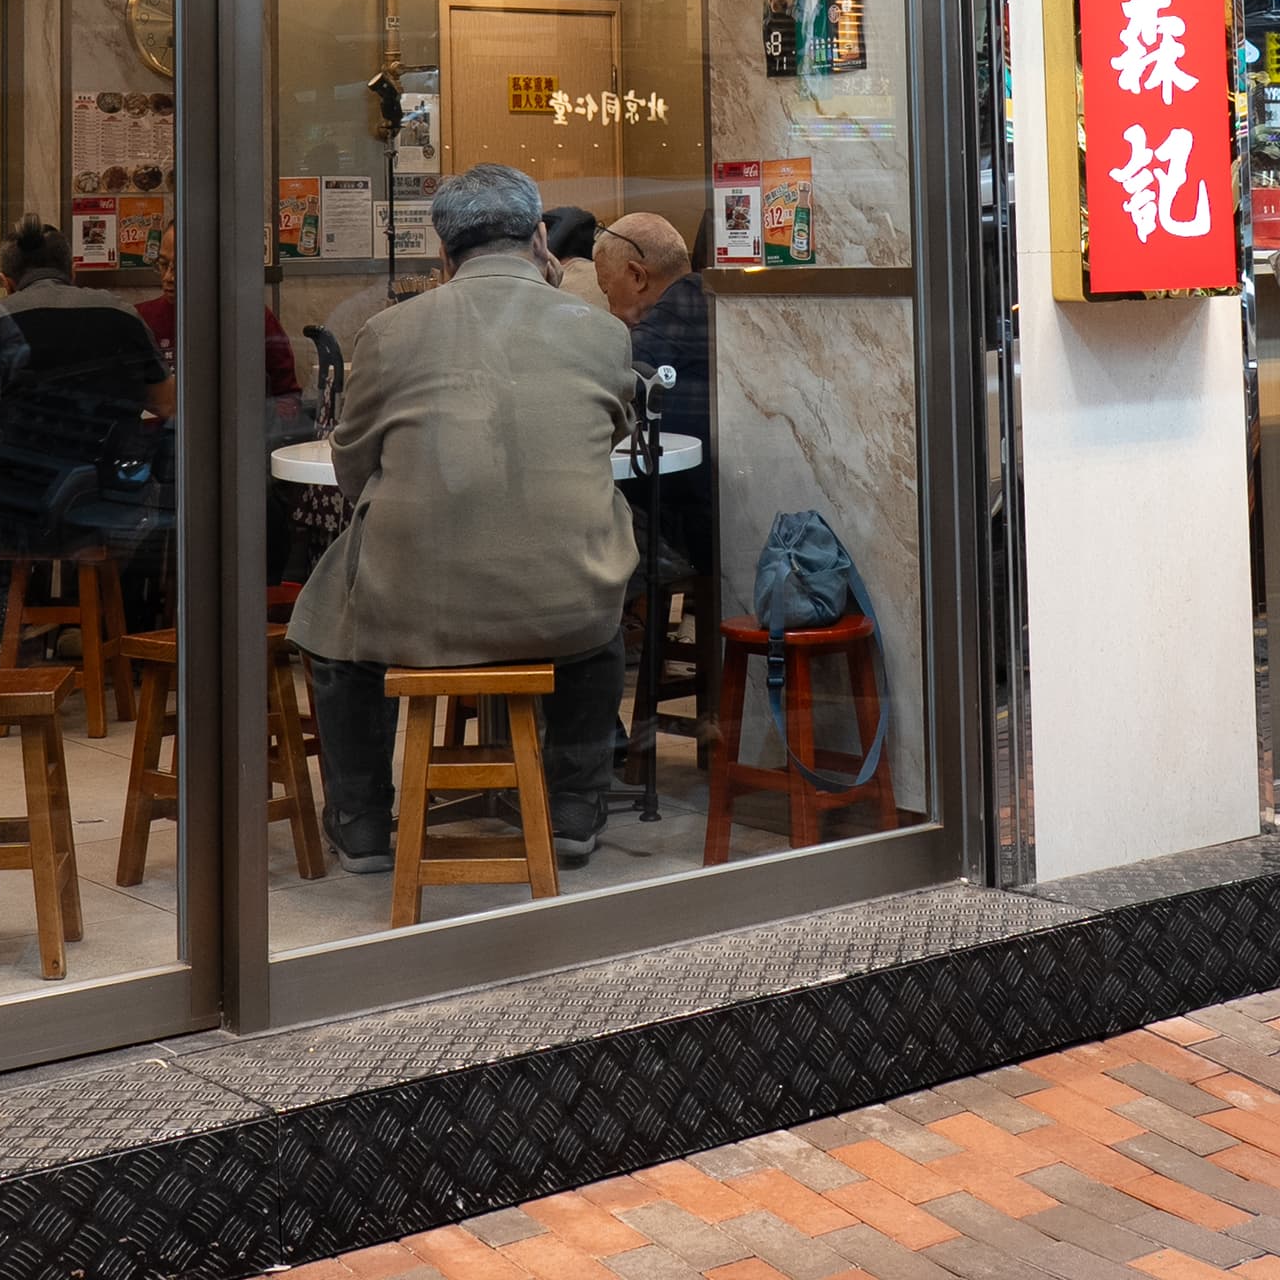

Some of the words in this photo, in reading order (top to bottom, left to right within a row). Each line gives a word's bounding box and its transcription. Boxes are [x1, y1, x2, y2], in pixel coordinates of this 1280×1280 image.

[512, 76, 554, 92] 私家重地
[765, 207, 783, 227] $12
